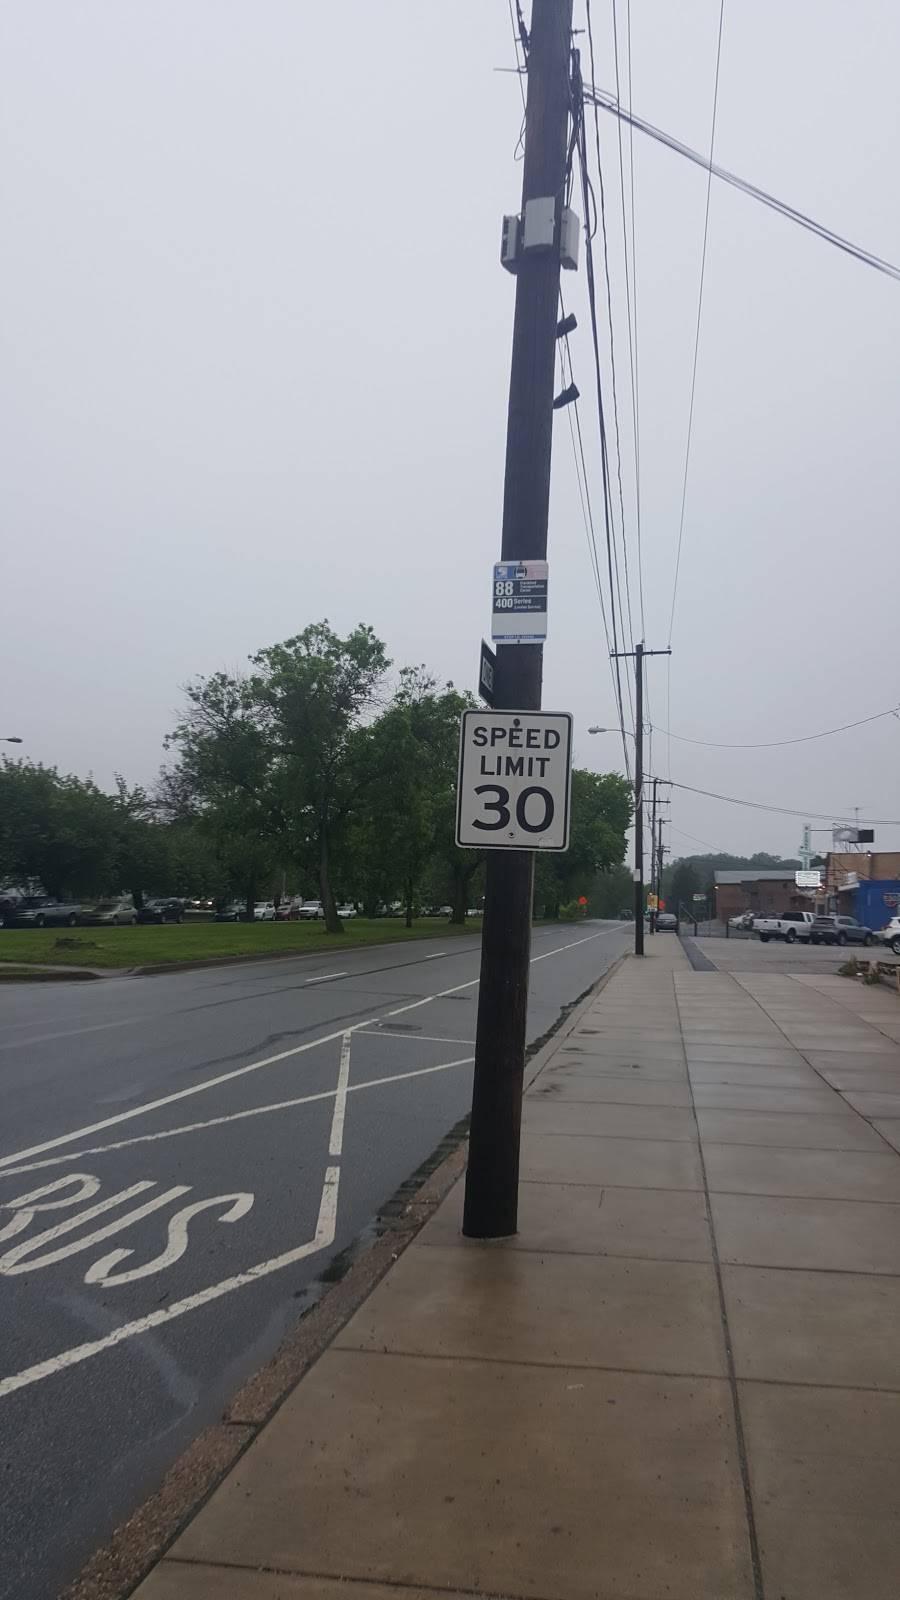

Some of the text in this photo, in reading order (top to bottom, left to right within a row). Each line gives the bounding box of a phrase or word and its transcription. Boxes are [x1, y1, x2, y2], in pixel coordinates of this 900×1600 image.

[495, 581, 514, 596] 88
[495, 598, 513, 609] 400
[472, 726, 561, 750] SPEED
[480, 755, 551, 778] LIMIT
[471, 784, 555, 833] 30
